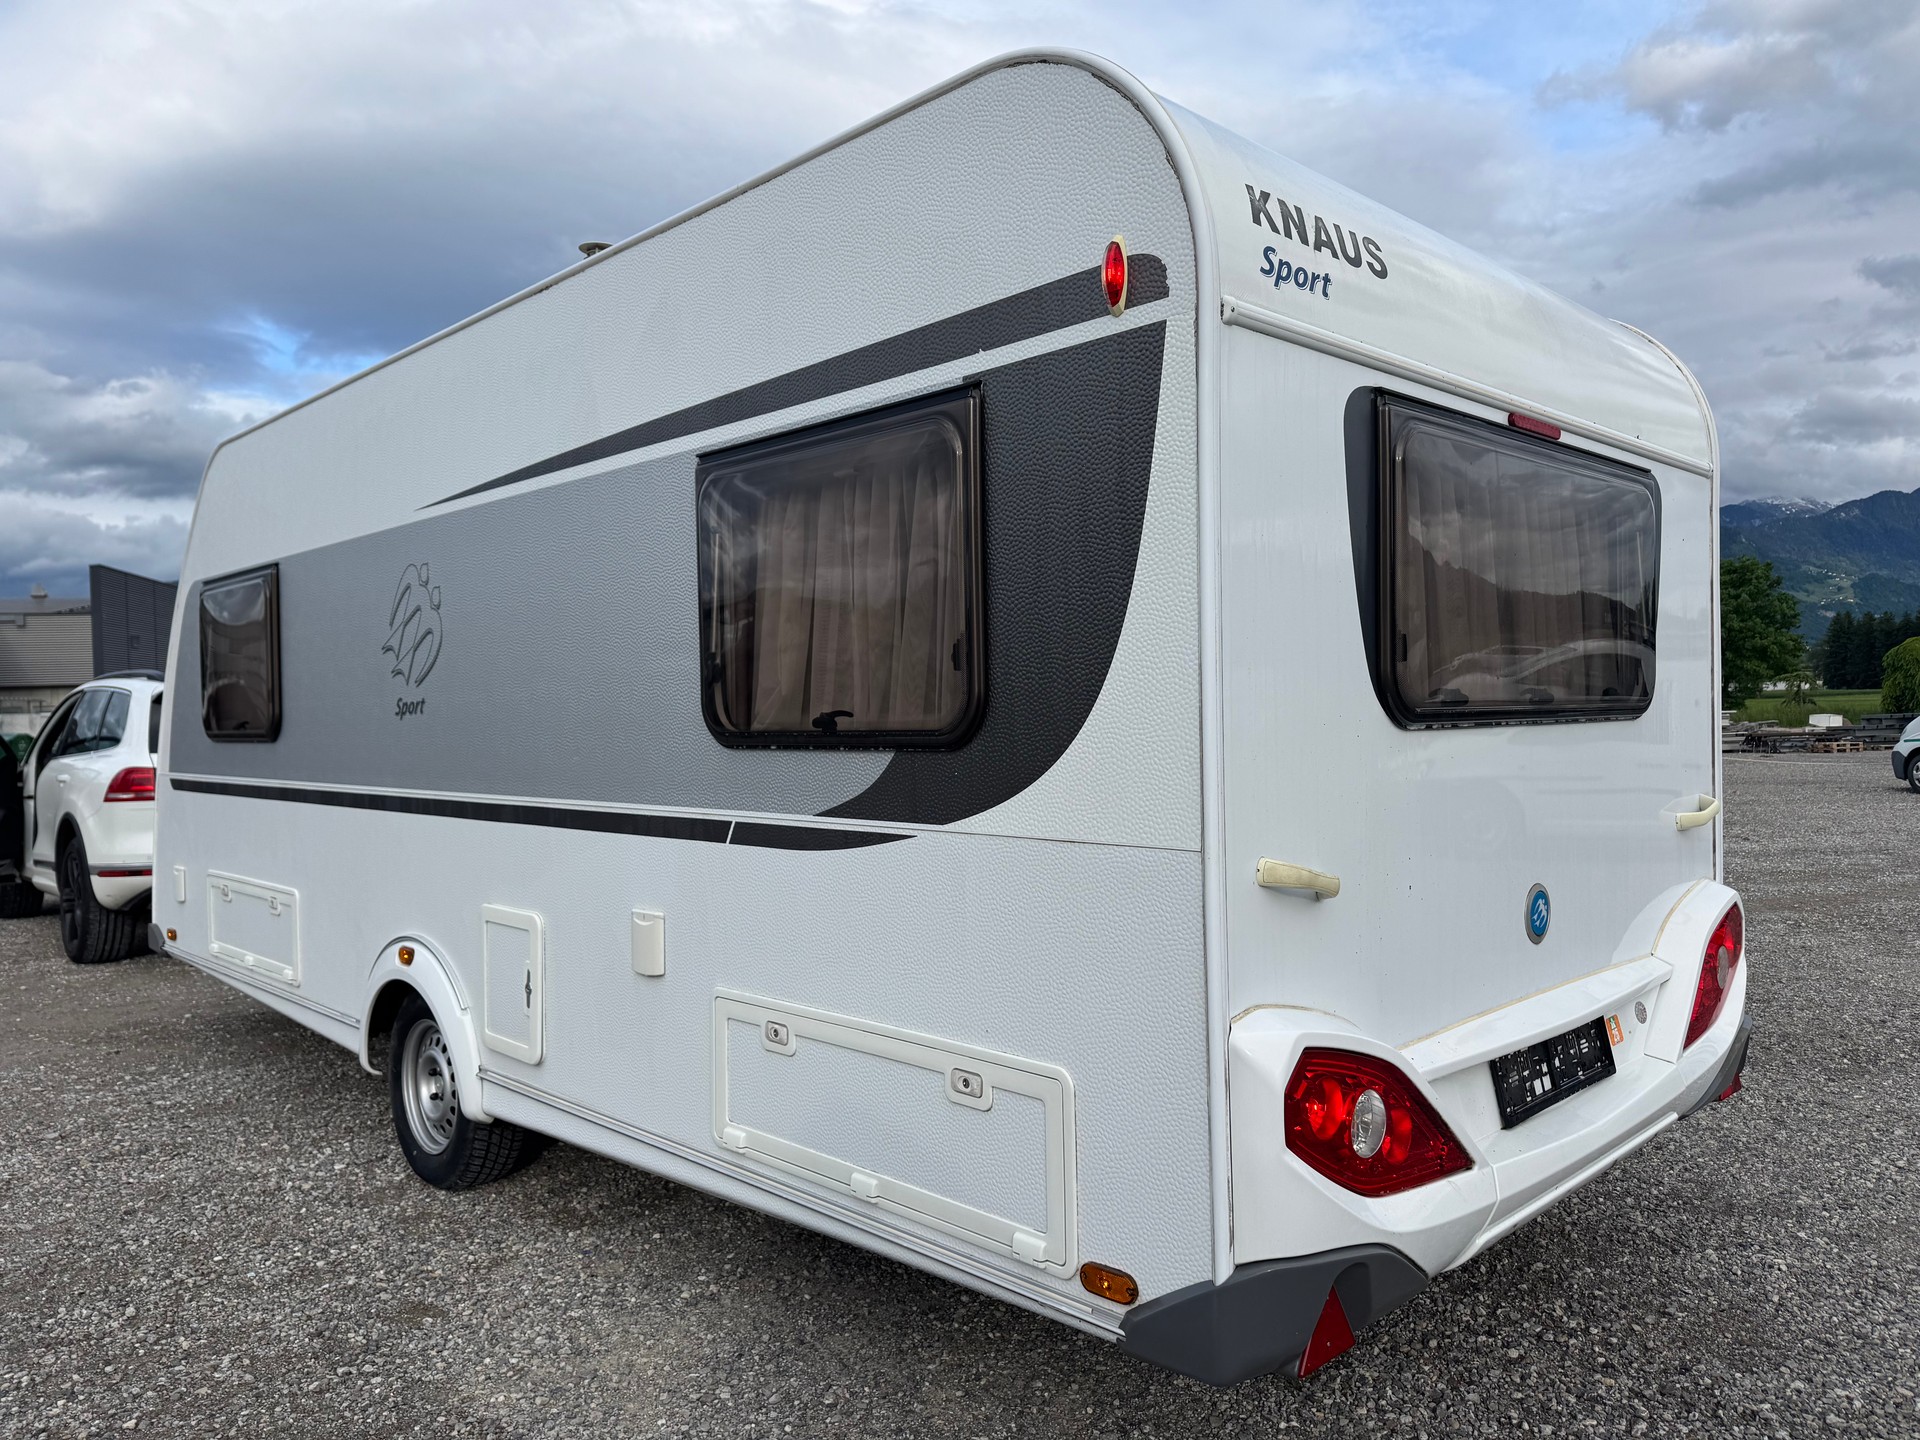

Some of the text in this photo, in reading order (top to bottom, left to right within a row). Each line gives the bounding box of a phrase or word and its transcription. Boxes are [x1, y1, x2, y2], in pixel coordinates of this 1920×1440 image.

[1245, 183, 1388, 280] KNAUS
[1260, 245, 1332, 300] Sport
[395, 697, 425, 720] Sport
